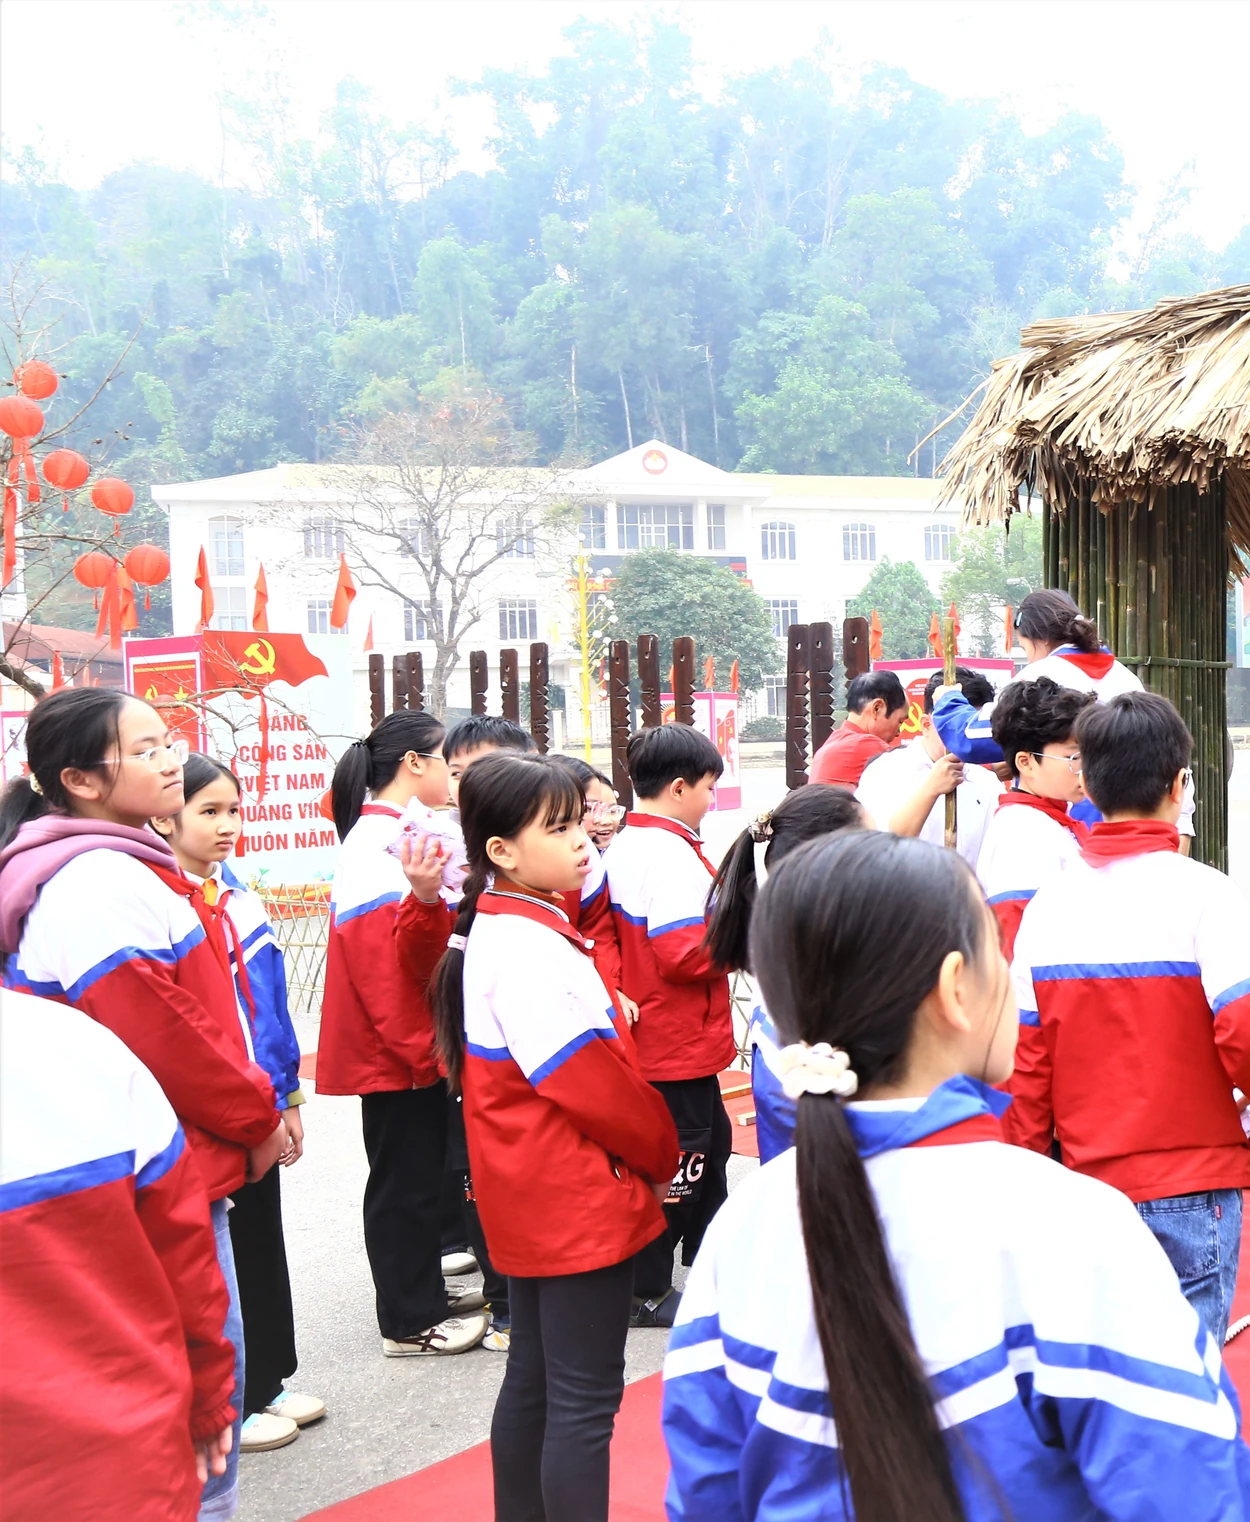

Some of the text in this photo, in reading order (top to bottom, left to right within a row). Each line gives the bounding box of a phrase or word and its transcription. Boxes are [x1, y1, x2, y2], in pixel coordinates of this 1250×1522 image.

[240, 739, 327, 766] CỘNG SẢN
[286, 773, 325, 790] NAM
[298, 802, 322, 819] VIN
[294, 828, 335, 850] NĂM
